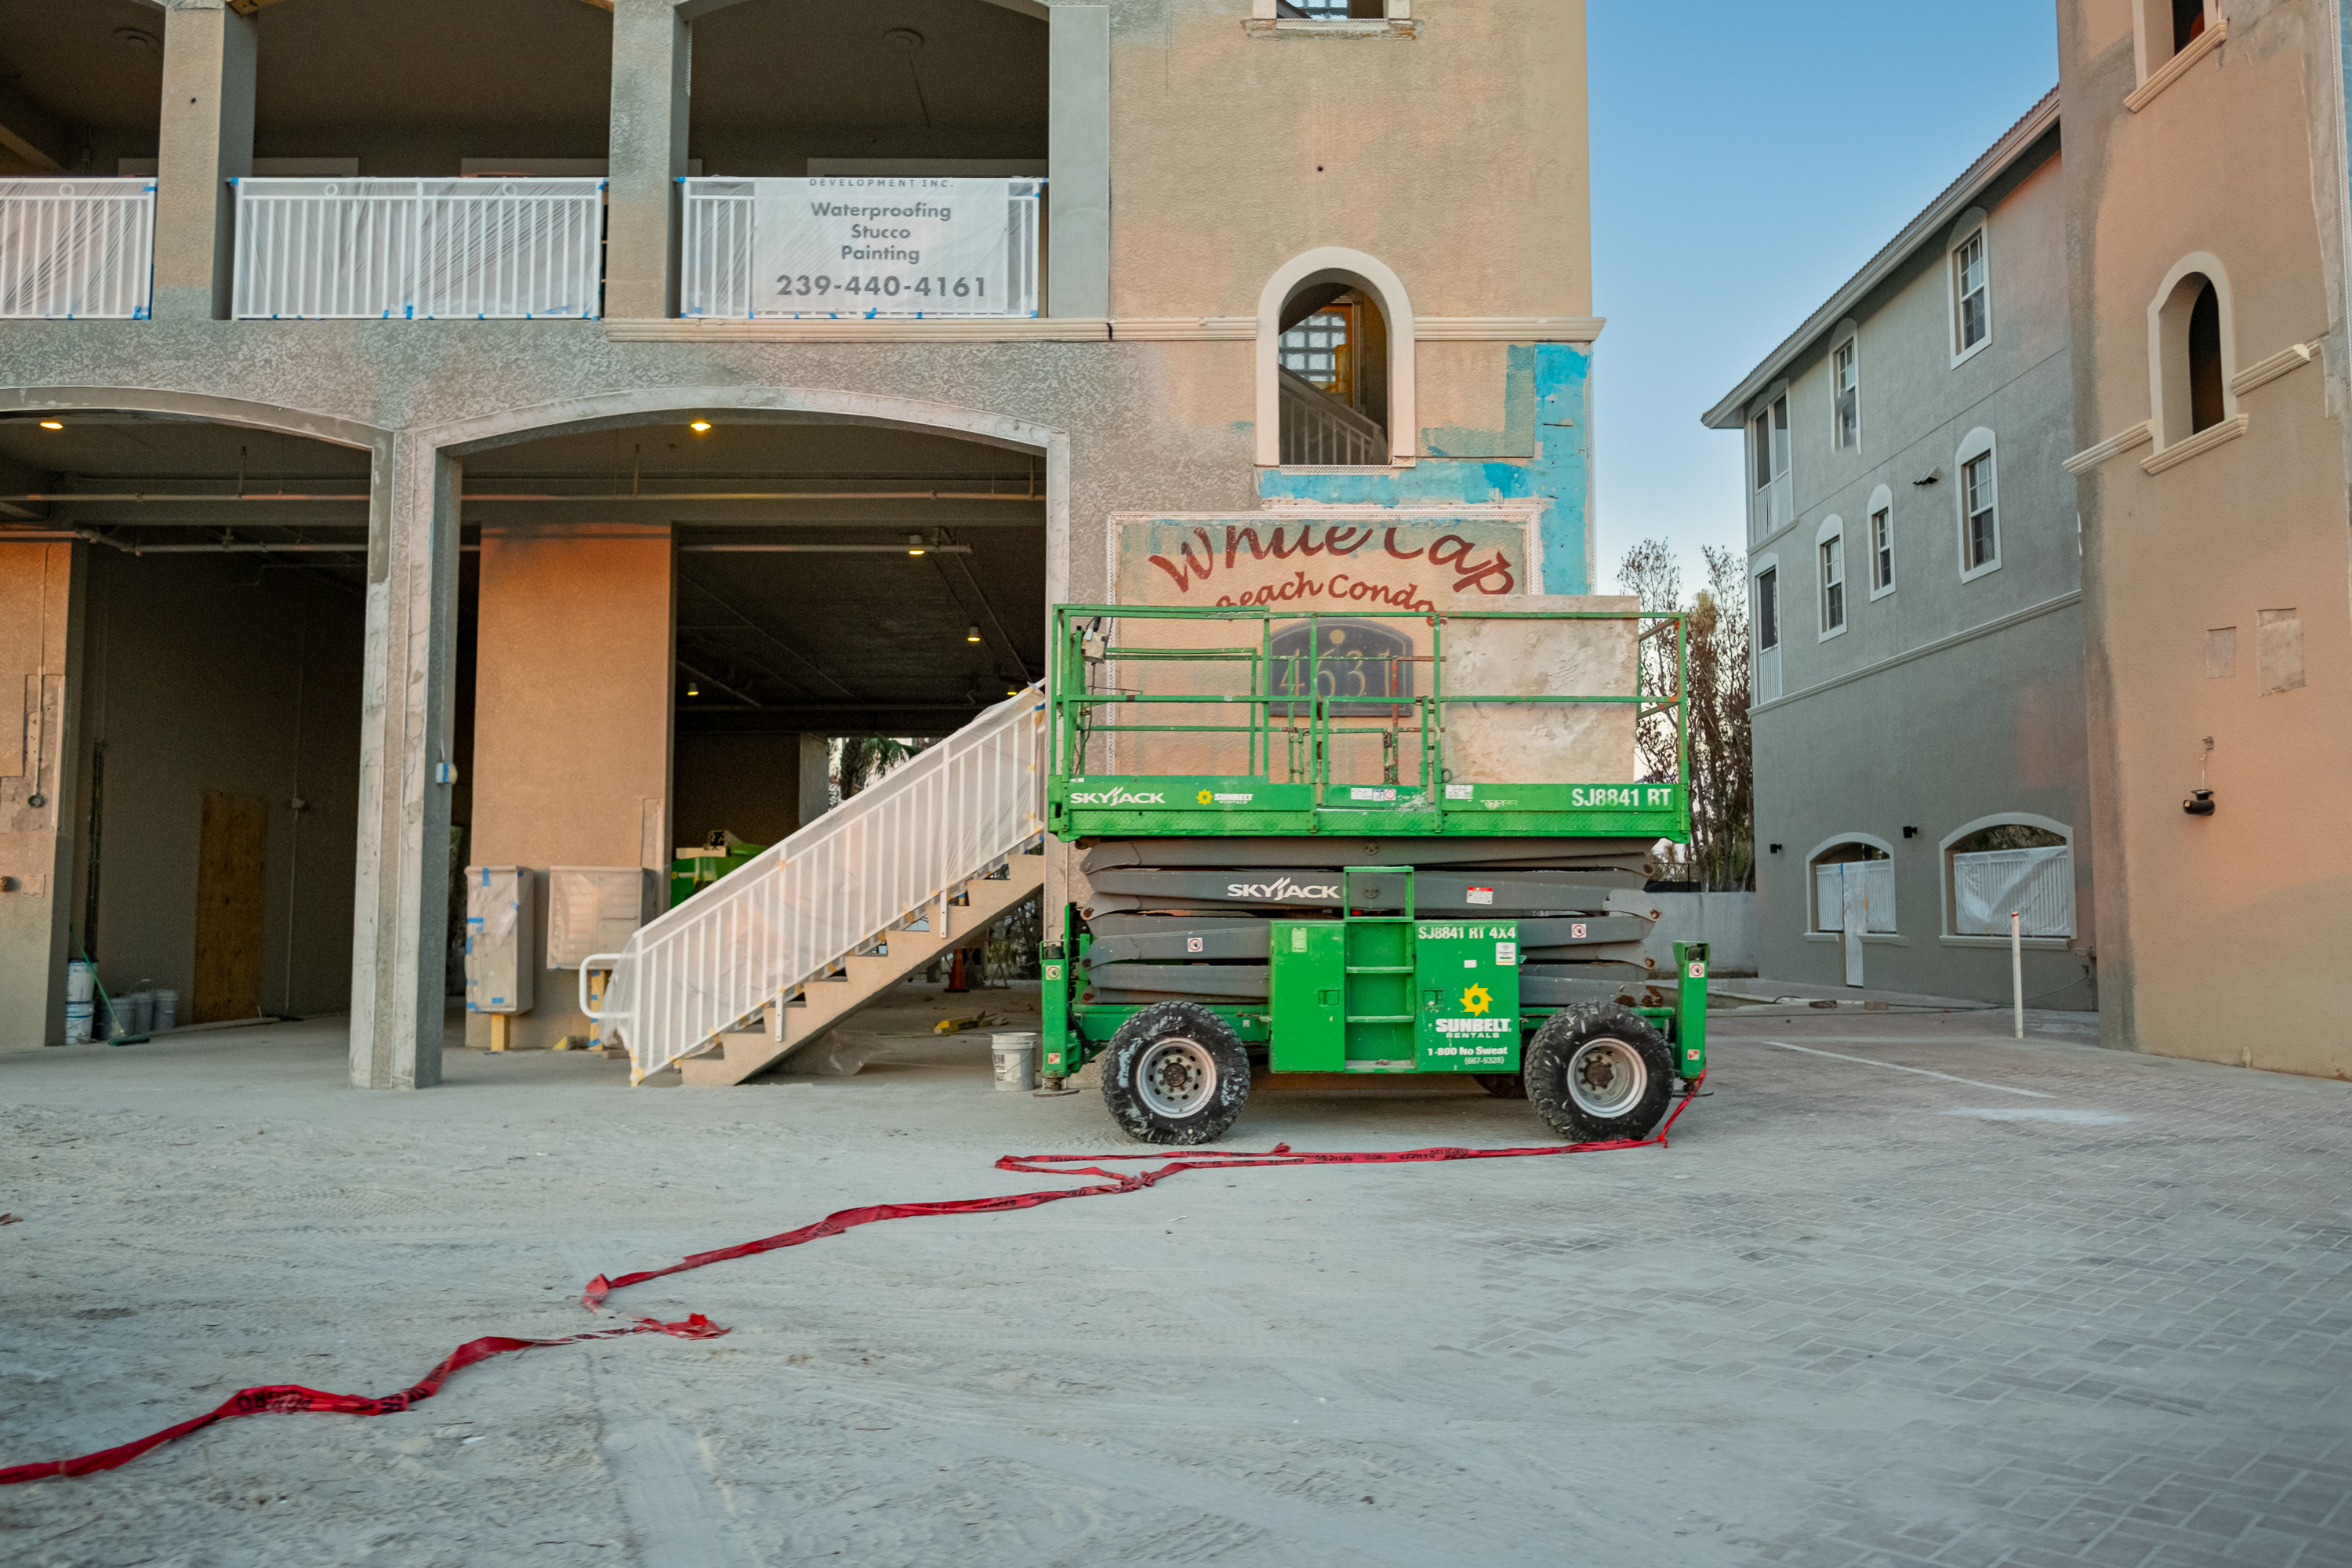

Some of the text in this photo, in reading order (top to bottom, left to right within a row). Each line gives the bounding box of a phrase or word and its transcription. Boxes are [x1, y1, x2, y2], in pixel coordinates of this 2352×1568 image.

[809, 178, 954, 187] DEVELOPMENT INC.
[811, 201, 952, 221] Waterproofing
[851, 223, 911, 238] Stucco
[841, 245, 920, 264] Painting
[776, 274, 985, 297] 239-440-4161
[1279, 648, 1391, 701] 4631
[1070, 786, 1166, 807] SKYJACK
[1571, 788, 1671, 807] SJ8841 RT
[1227, 877, 1341, 901] SKYJACK
[1418, 926, 1464, 939] SJ8841
[1468, 927, 1486, 939] RT
[1436, 1018, 1511, 1033] SUNBELT
[1428, 1047, 1508, 1056] 1-800 No Sweat
